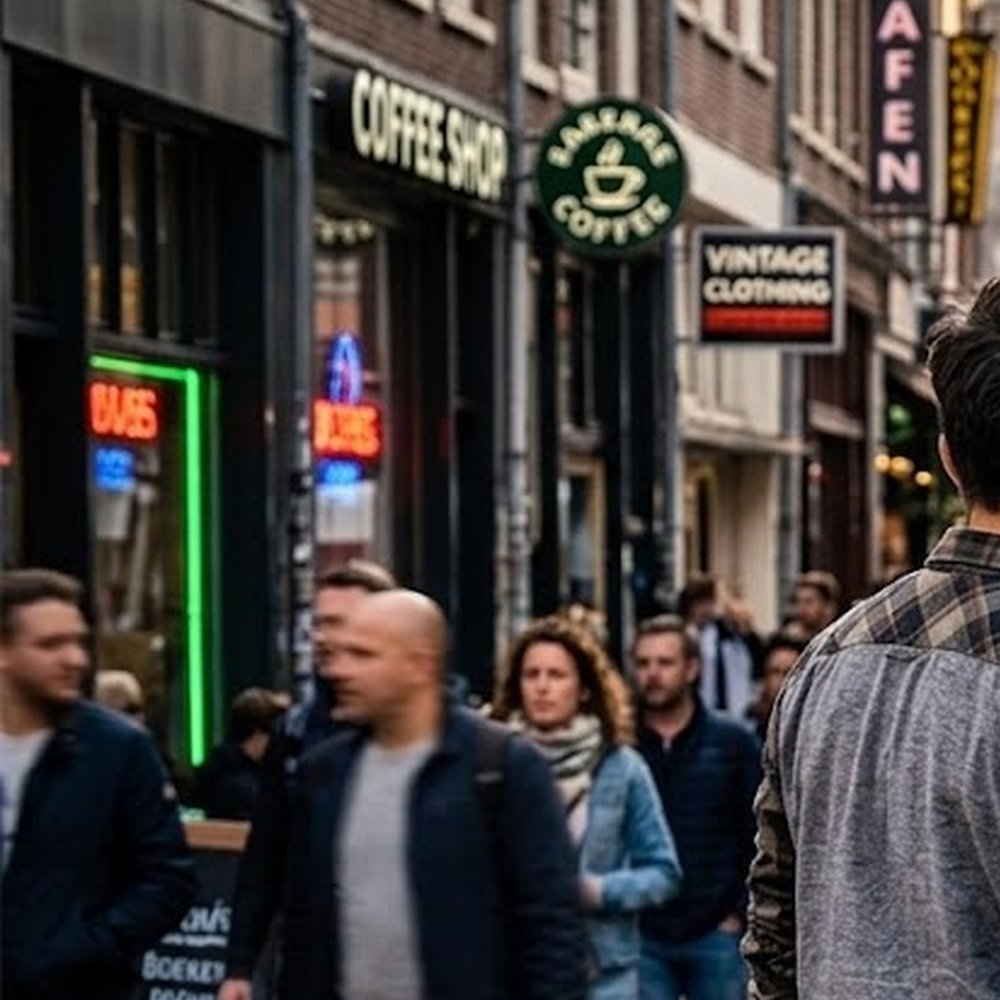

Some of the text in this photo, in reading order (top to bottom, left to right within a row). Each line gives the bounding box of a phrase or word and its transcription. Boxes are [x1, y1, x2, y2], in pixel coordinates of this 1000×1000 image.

[352, 68, 508, 202] COFFEE SHOP
[552, 193, 672, 245] COFFEE
[705, 243, 829, 276] VINTAGE
[703, 276, 831, 305] CLOTHING
